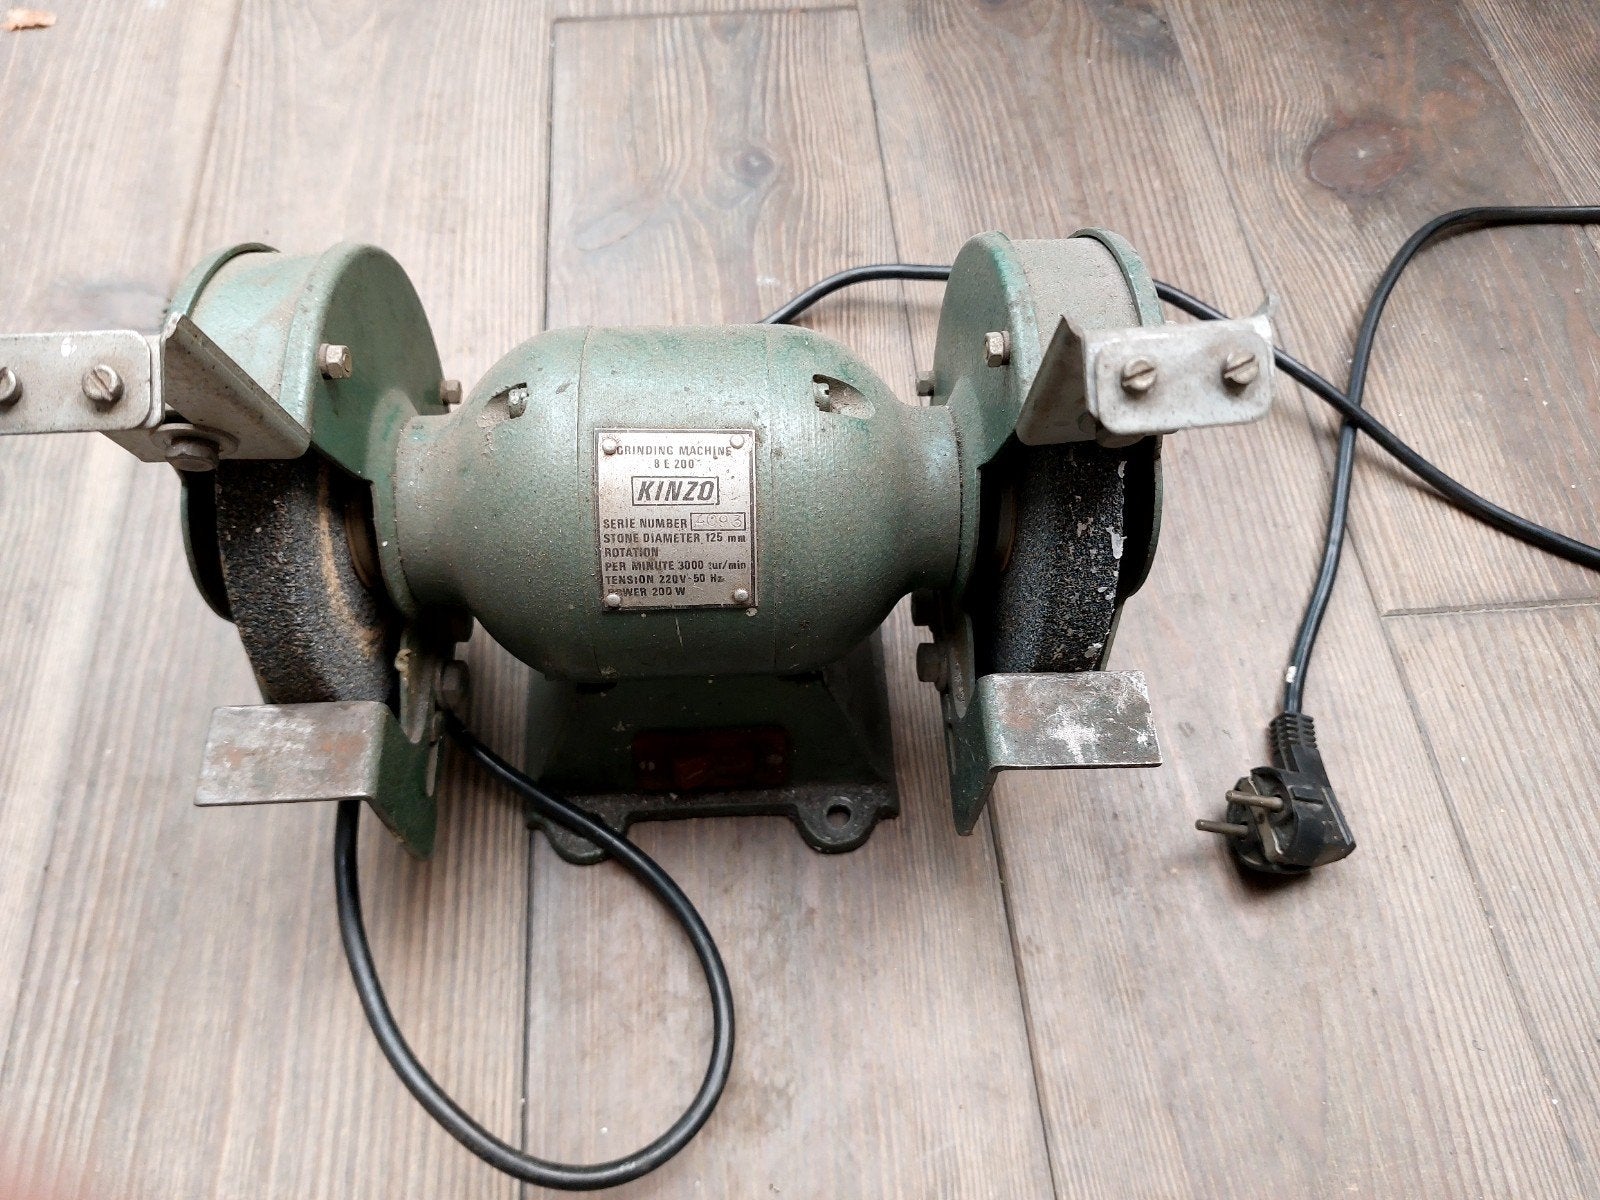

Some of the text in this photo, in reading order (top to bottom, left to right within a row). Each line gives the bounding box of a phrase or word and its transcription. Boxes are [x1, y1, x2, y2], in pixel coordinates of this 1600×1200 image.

[617, 445, 732, 457] GRINDING MACHINE
[674, 459, 695, 469] 200
[637, 481, 715, 501] KINZO
[603, 519, 636, 529] SERIE
[639, 518, 688, 529] NUMBER
[603, 532, 746, 544] STONE DIAMETER 125 mm
[604, 547, 659, 558] ROTATION
[605, 562, 626, 572] PER
[631, 561, 674, 572] MINUTE
[678, 560, 704, 571] 3000
[605, 575, 654, 585] TENSION
[652, 587, 673, 597] 200
[675, 587, 686, 597] W
